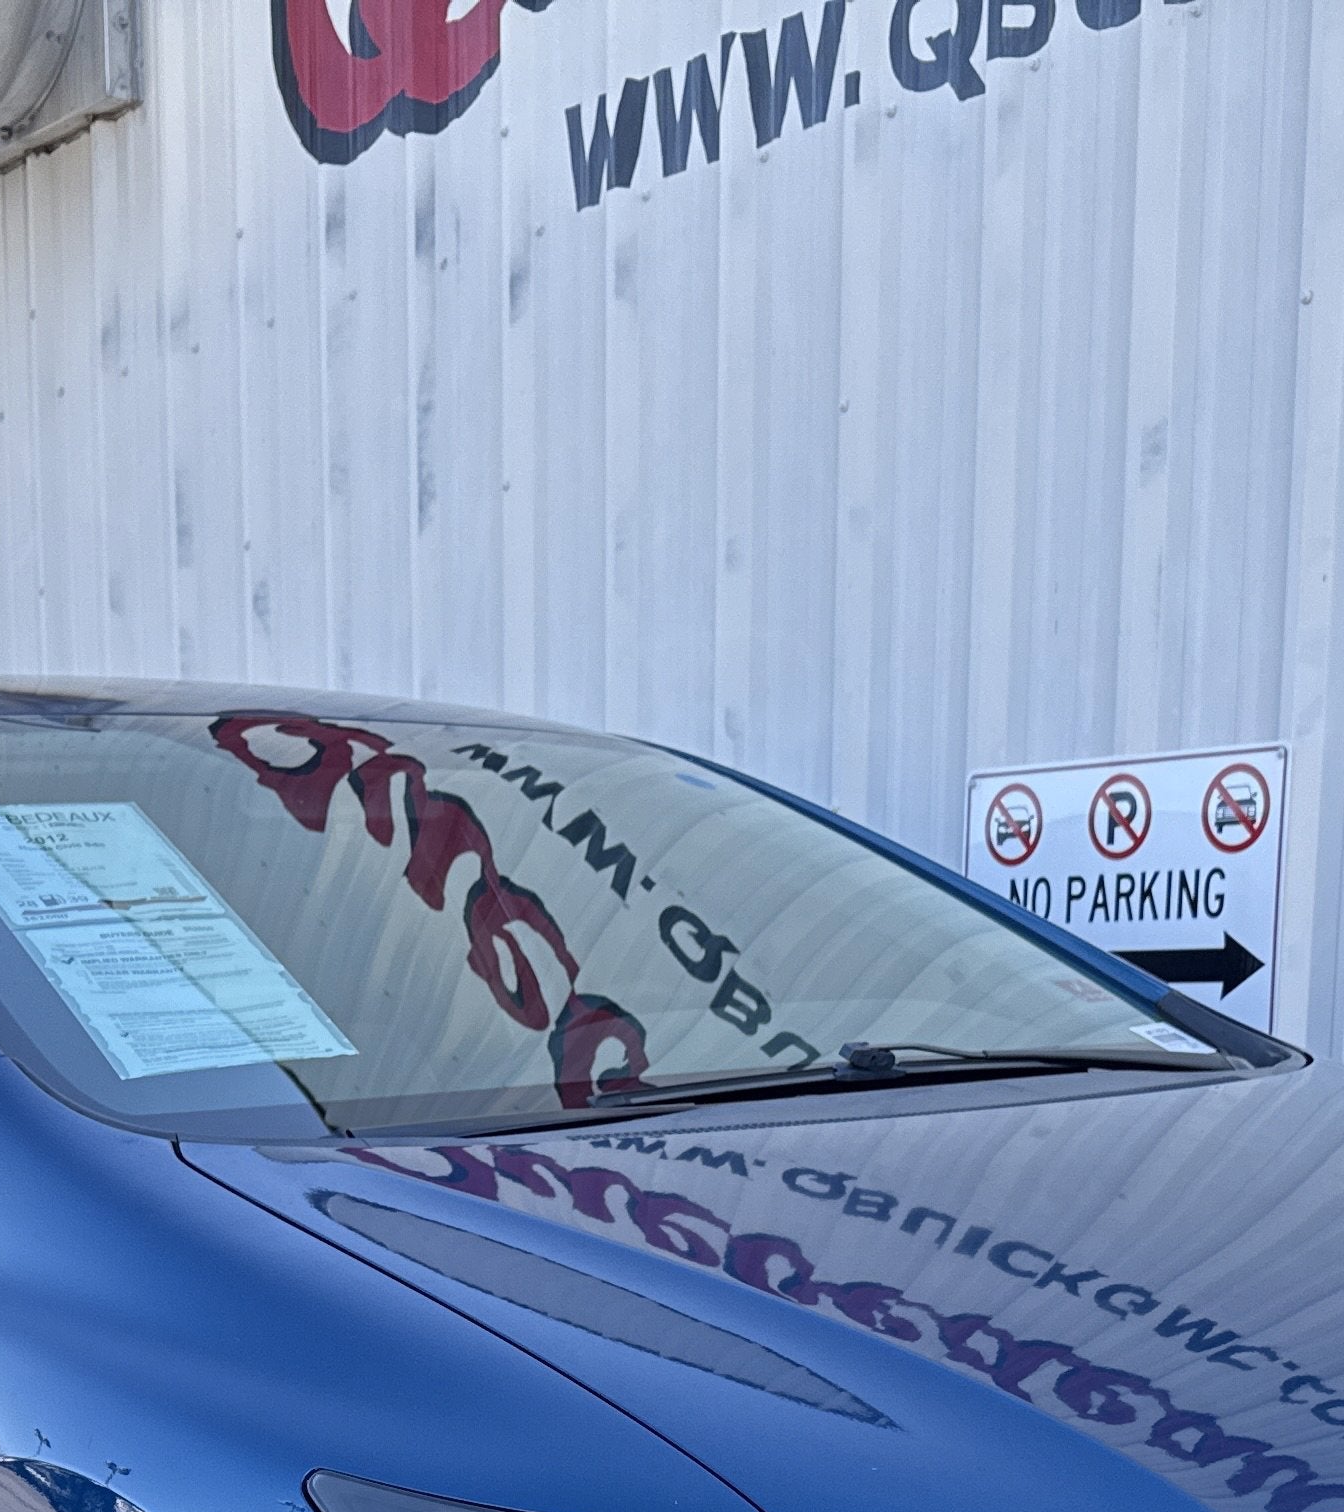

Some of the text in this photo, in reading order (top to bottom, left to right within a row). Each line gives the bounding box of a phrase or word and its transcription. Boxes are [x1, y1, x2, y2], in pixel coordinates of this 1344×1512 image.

[564, 0, 1196, 212] WWW.QB
[25, 833, 69, 846] 2012
[1009, 866, 1227, 924] NO PARKING
